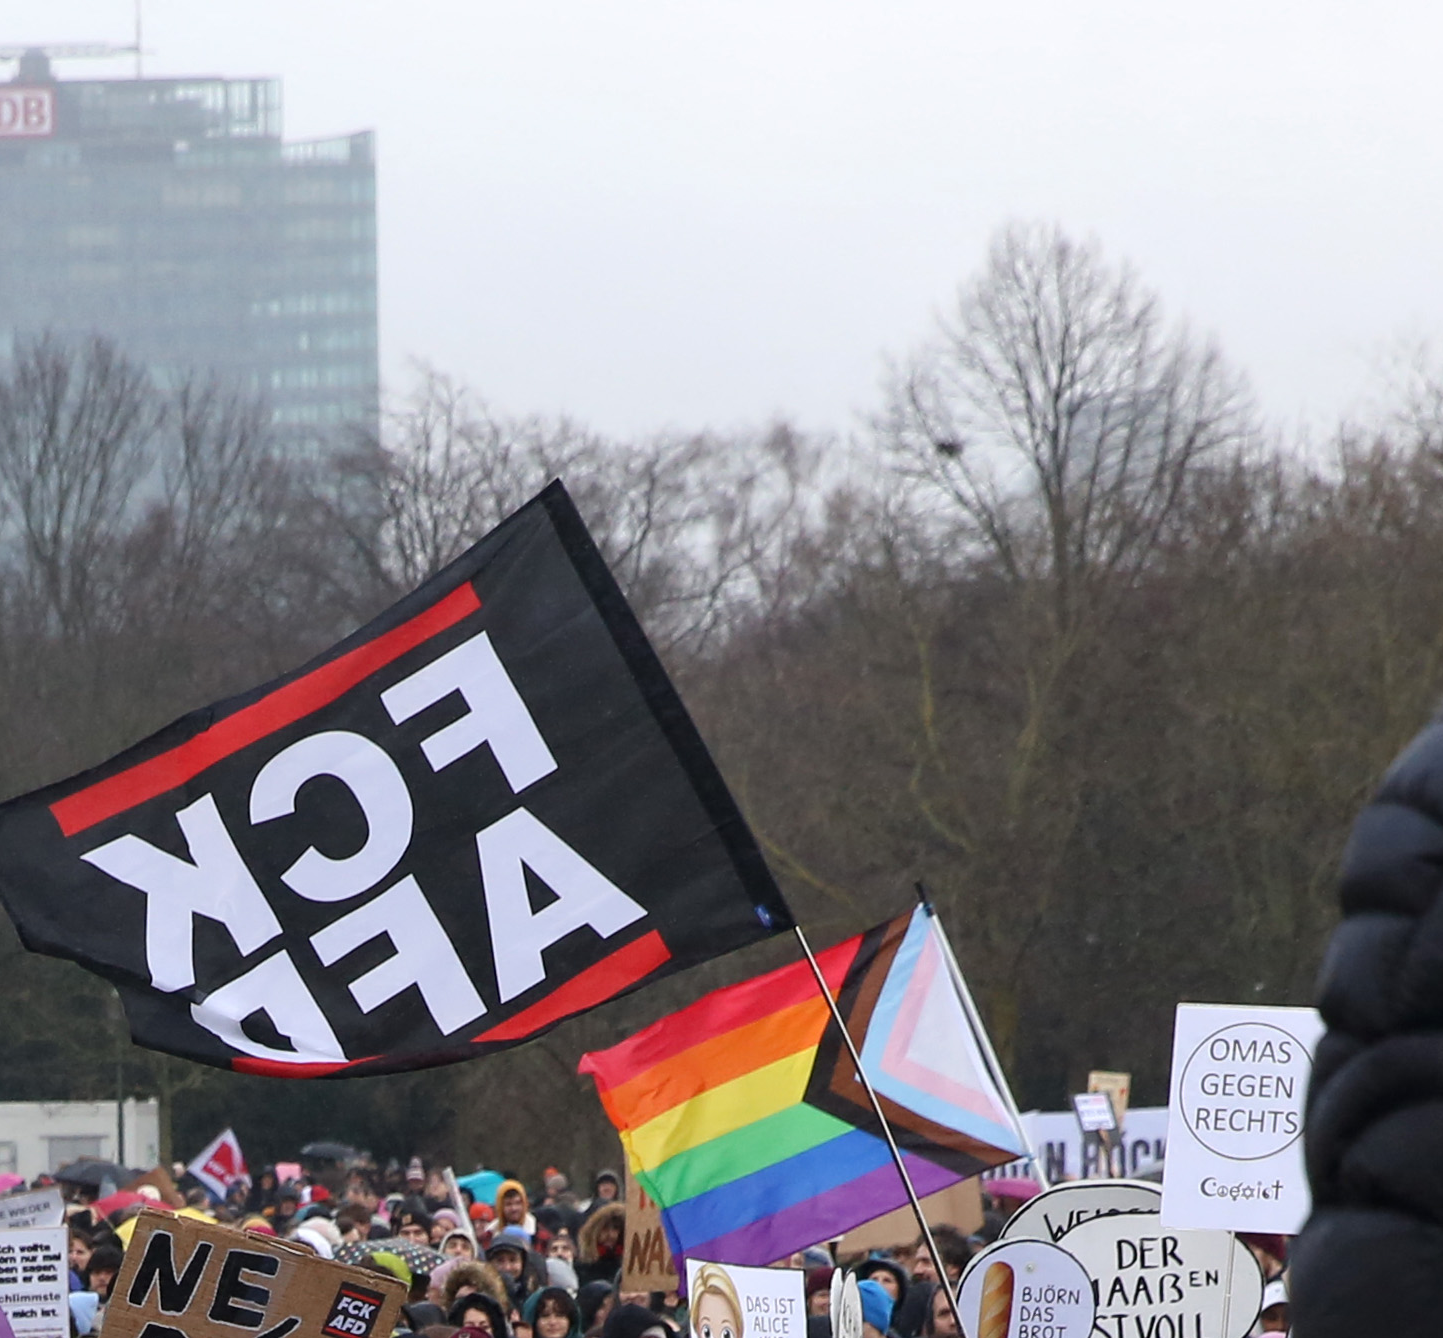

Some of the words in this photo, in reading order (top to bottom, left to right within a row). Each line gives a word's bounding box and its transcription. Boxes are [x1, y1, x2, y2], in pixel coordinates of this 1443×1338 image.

[1209, 1038, 1292, 1064] OMAS
[1201, 1073, 1294, 1099] GEGEN
[1195, 1108, 1299, 1134] RECHTS
[1117, 1236, 1183, 1270] DER
[746, 1296, 770, 1314] DAS
[774, 1298, 796, 1314] IST
[1022, 1285, 1081, 1305] BJÖRN
[337, 1296, 376, 1320] FCK
[1020, 1306, 1055, 1322] DAS
[328, 1314, 367, 1336] AFD
[753, 1317, 790, 1334] ALICE
